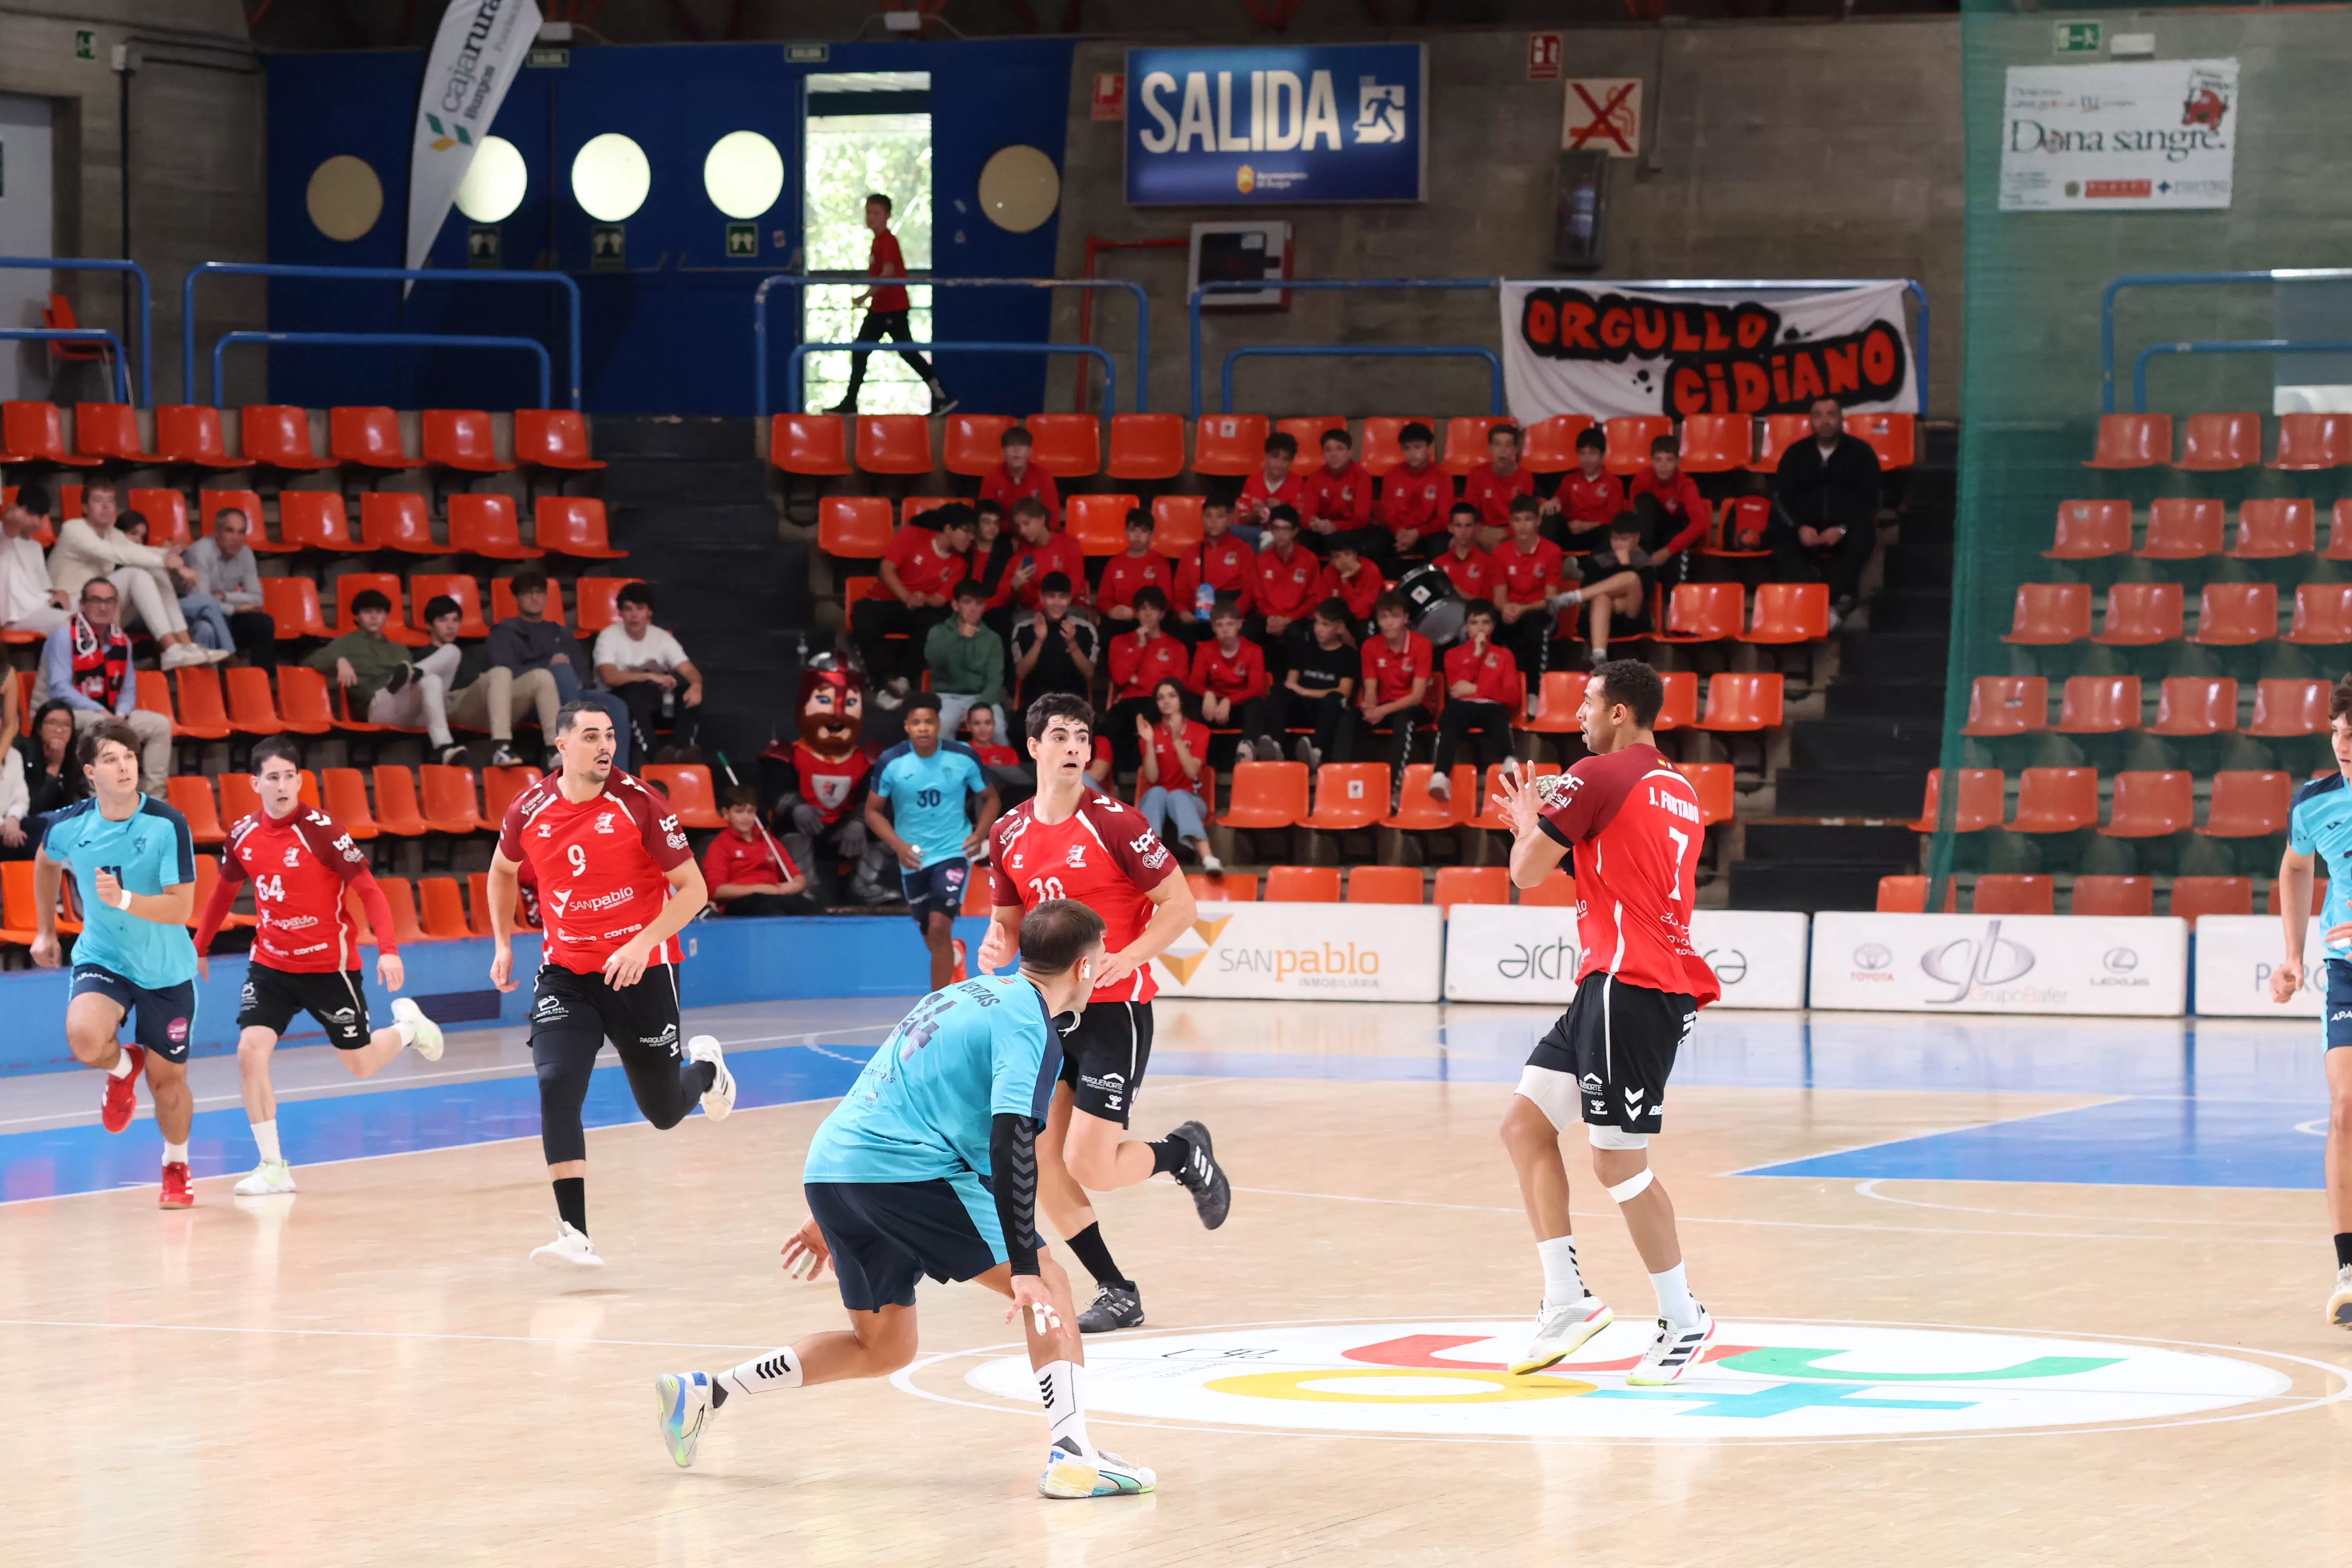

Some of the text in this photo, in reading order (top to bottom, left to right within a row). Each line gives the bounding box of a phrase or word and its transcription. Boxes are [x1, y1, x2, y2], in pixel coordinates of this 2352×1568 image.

[1140, 70, 1342, 153] SALIDA
[2010, 119, 2103, 154] Dona
[1524, 294, 1774, 357] ORGULLO
[916, 789, 940, 808] 30
[1649, 786, 1700, 824] J. FURTADO
[567, 844, 586, 877] 9
[1668, 826, 1689, 901] 7
[256, 874, 286, 902] 64
[569, 886, 634, 911] SANpablo
[604, 923, 642, 939] correa
[1219, 941, 1380, 982] SANpablo
[1298, 978, 1380, 988] INMOBILIARIA
[1851, 972, 1894, 982] TOYOTA
[2090, 977, 2150, 986] LEXUS
